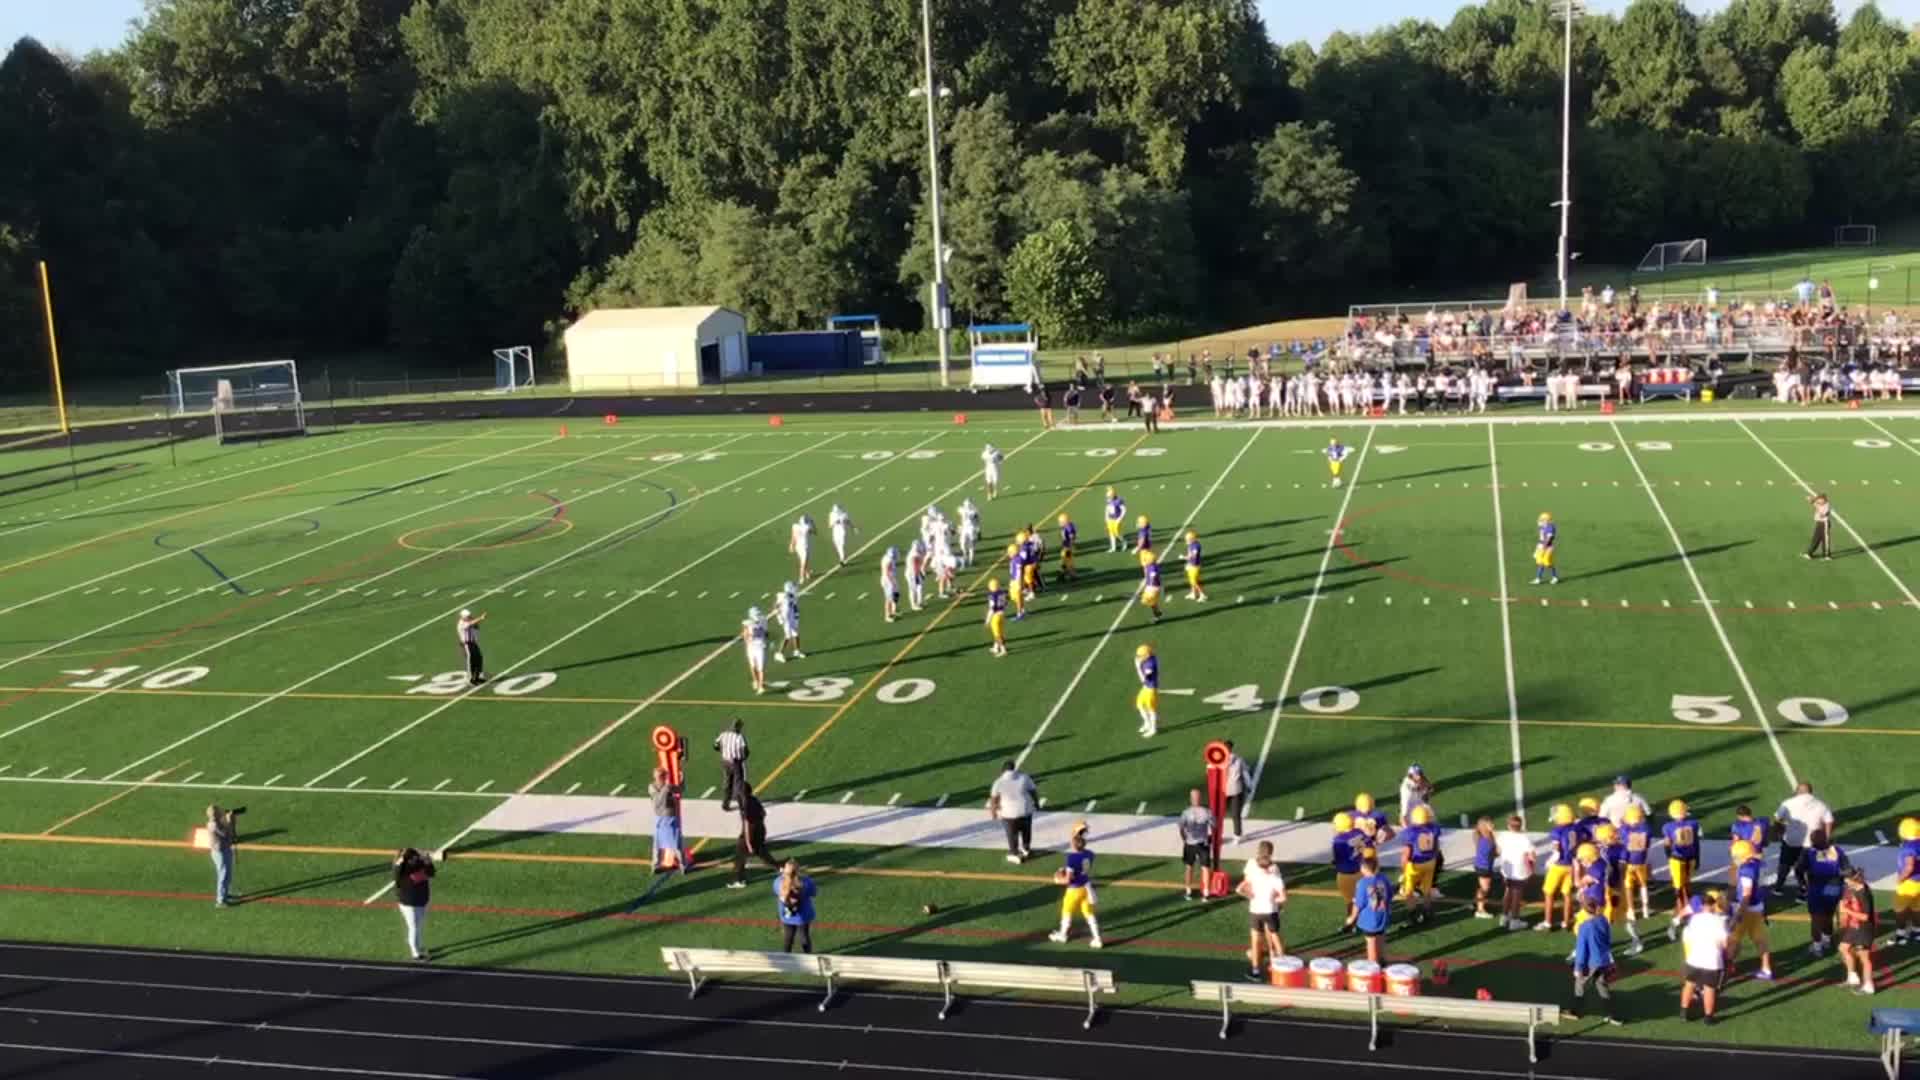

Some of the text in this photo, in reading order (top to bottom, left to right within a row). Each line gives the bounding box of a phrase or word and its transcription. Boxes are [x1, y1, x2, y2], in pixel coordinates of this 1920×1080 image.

[67, 665, 210, 688] 10
[788, 677, 936, 703] 30
[1202, 684, 1360, 713] 40
[1671, 694, 1849, 726] 50
